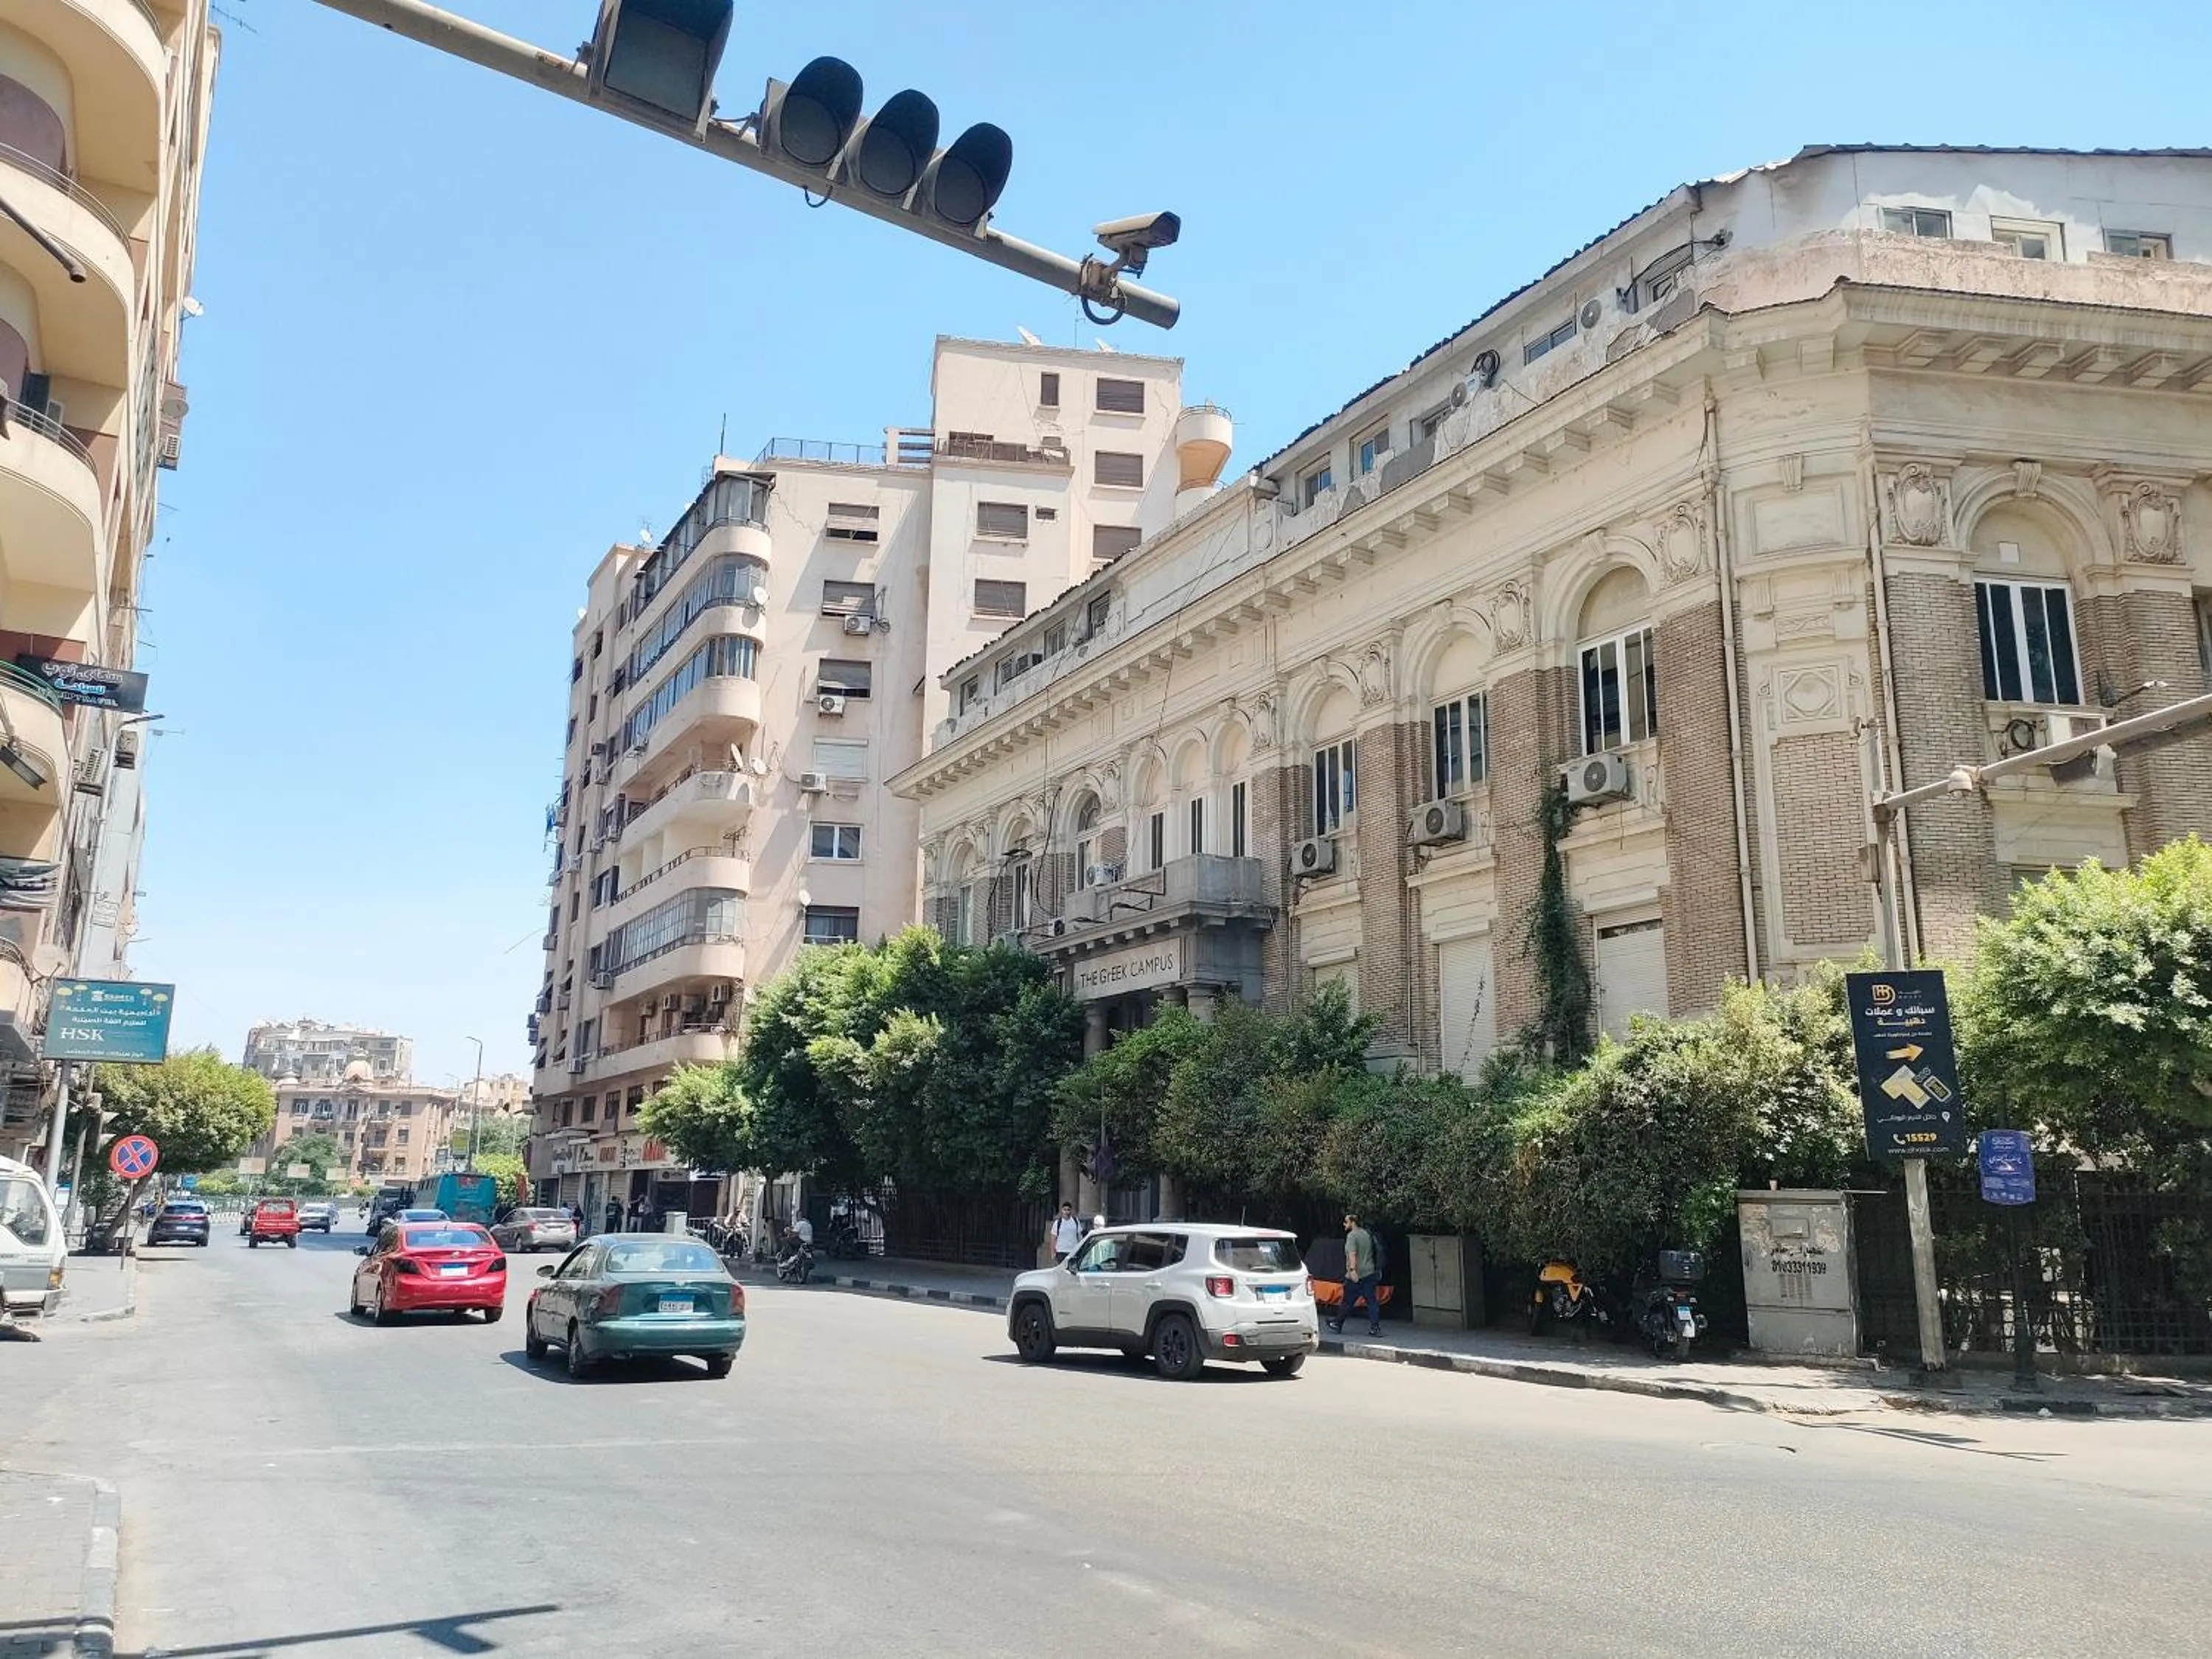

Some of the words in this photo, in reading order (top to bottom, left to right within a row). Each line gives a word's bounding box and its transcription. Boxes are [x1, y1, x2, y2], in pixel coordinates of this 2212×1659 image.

[1080, 970, 1098, 988] THE
[1130, 953, 1174, 977] CAMPUS
[60, 1027, 105, 1042] HSK
